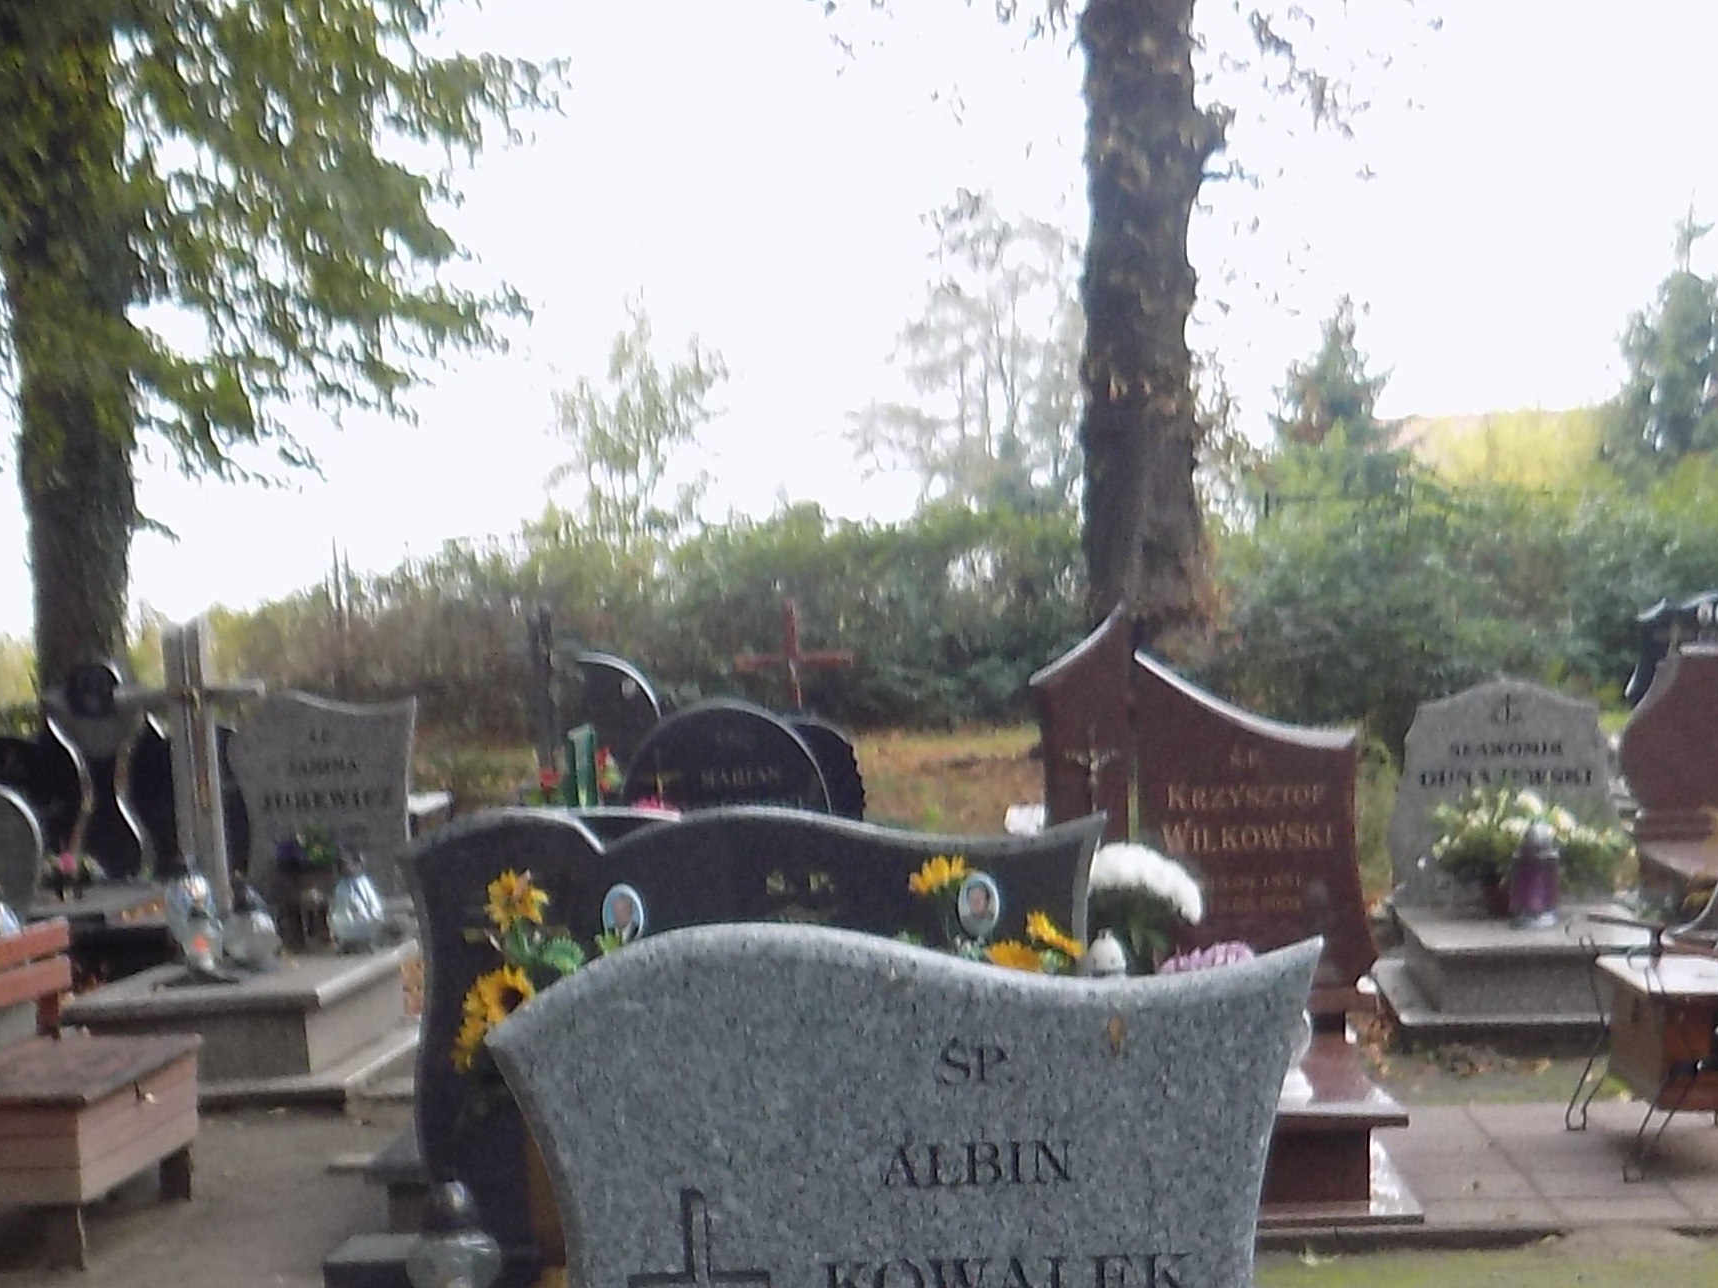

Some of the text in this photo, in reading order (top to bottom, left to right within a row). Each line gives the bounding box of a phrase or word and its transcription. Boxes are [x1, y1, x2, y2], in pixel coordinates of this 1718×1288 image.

[1166, 780, 1327, 810] KRZYSZTOF
[1161, 821, 1334, 853] WILKOWSKI
[883, 1138, 1073, 1189] ALBIN
